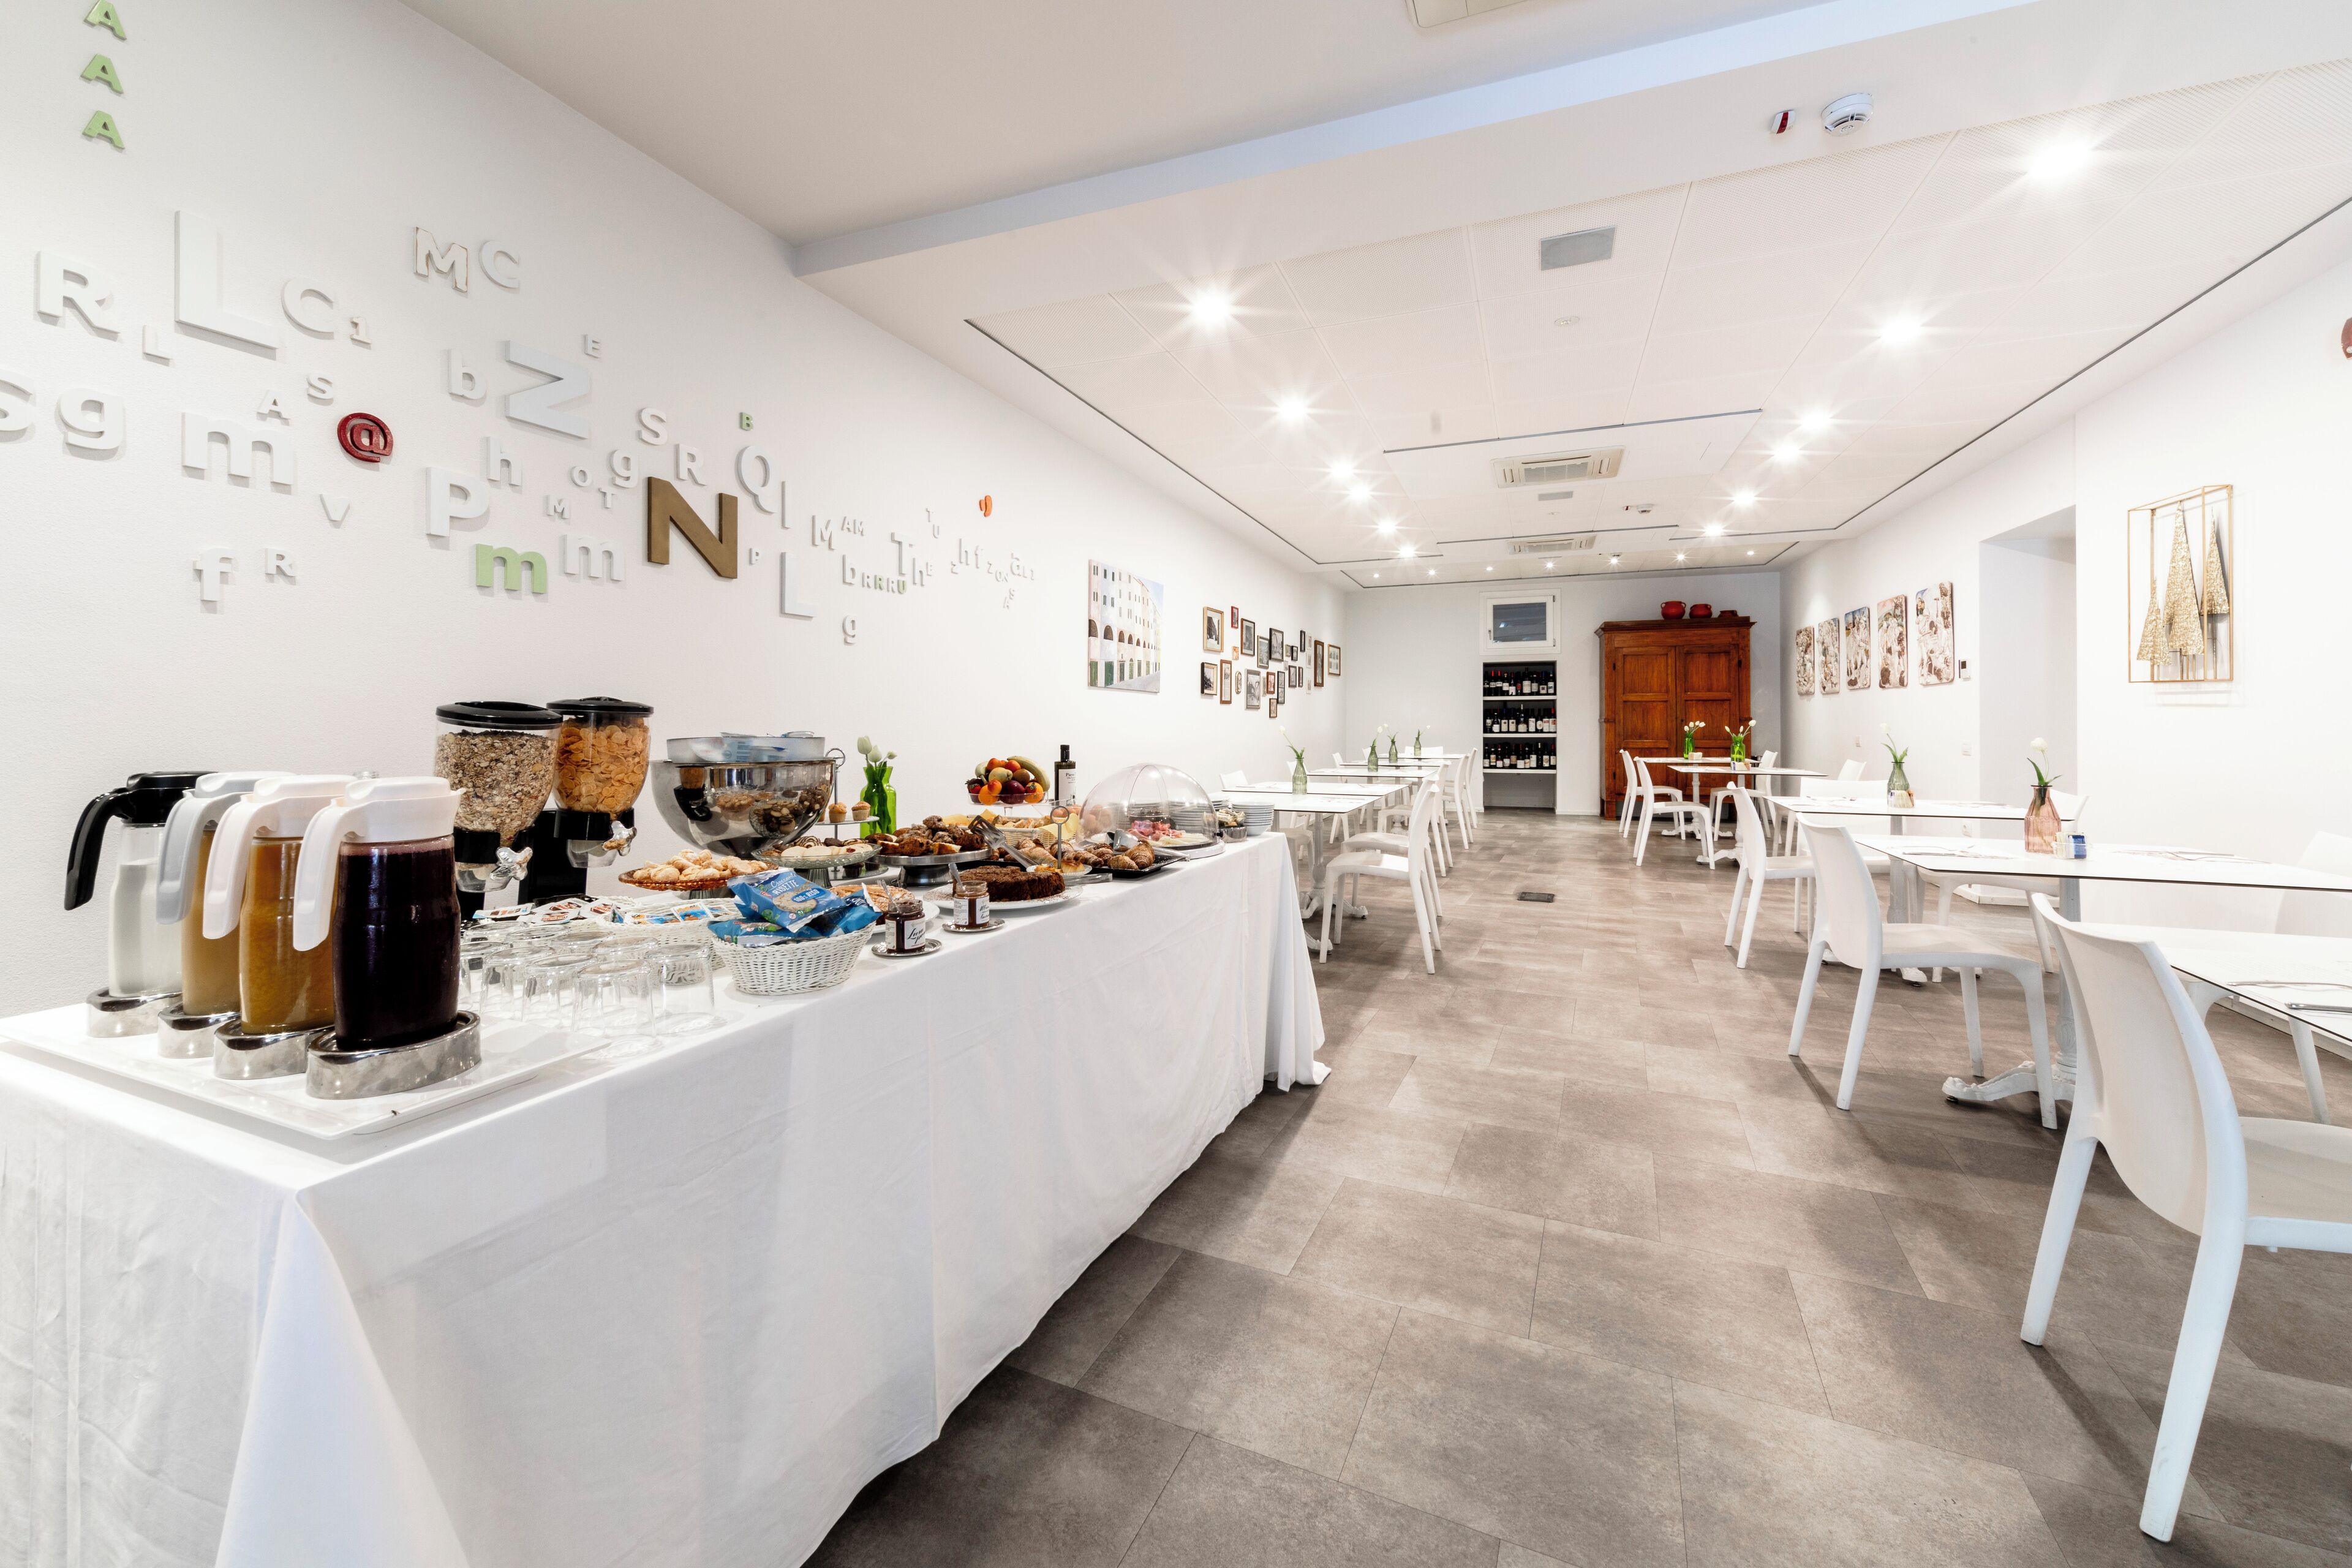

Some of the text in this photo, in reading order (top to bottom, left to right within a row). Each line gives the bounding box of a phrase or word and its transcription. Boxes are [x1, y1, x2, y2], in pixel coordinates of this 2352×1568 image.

[83, 0, 127, 41] A
[80, 53, 124, 94] A
[82, 110, 125, 149] A
[36, 251, 120, 333] R
[175, 210, 279, 349] L
[282, 277, 334, 333] C
[350, 317, 372, 344] 1
[584, 334, 601, 358] E
[307, 372, 334, 399] S
[448, 349, 487, 400] b
[60, 388, 124, 449] g
[257, 390, 291, 419] A
[740, 412, 754, 431] B
[337, 413, 394, 462] @
[638, 407, 668, 445] S
[183, 412, 296, 484] m
[488, 436, 522, 486] h
[611, 449, 638, 488] g
[676, 443, 707, 486] R
[598, 488, 615, 508] T
[736, 445, 777, 513] Q
[427, 467, 490, 537] P
[546, 495, 570, 519] M
[647, 477, 737, 579] N
[812, 514, 837, 550] M
[193, 547, 235, 601] f
[265, 548, 296, 577] R
[475, 543, 547, 594] m
[564, 534, 625, 581] m
[750, 548, 760, 565] P
[842, 554, 857, 586] b
[781, 552, 816, 617] L
[842, 614, 857, 646] g
[772, 880, 799, 895] RISETTE
[805, 889, 820, 897] RISO
